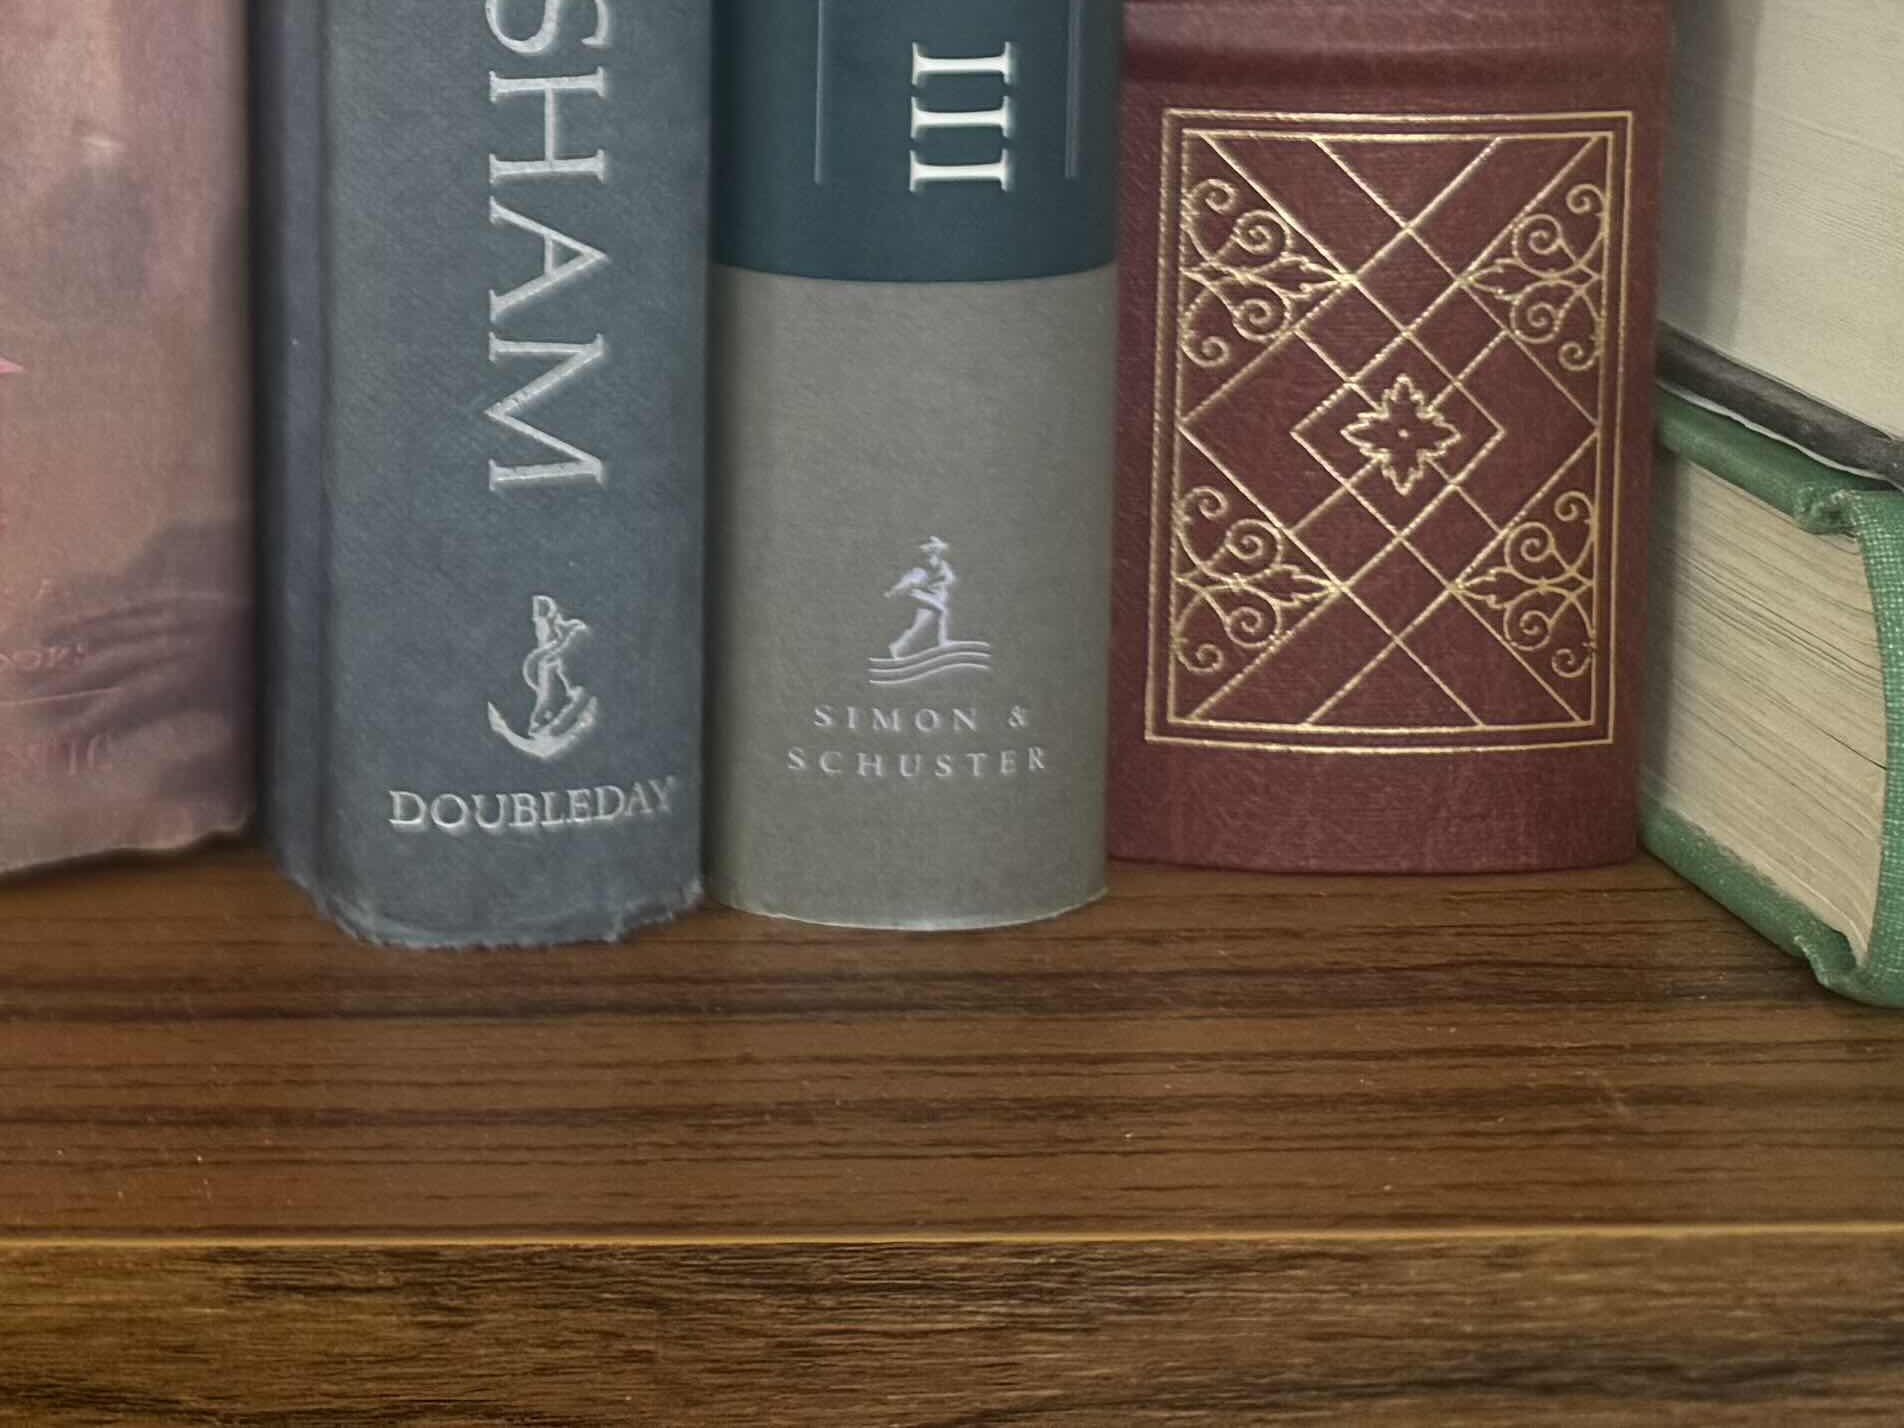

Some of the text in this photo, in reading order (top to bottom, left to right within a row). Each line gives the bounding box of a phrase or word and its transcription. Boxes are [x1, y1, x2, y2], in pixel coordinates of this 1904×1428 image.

[907, 42, 1018, 196] III
[813, 703, 1032, 734] SIMON &
[786, 746, 1048, 778] SCHUSTER
[389, 776, 679, 834] DOUBLEDAY
